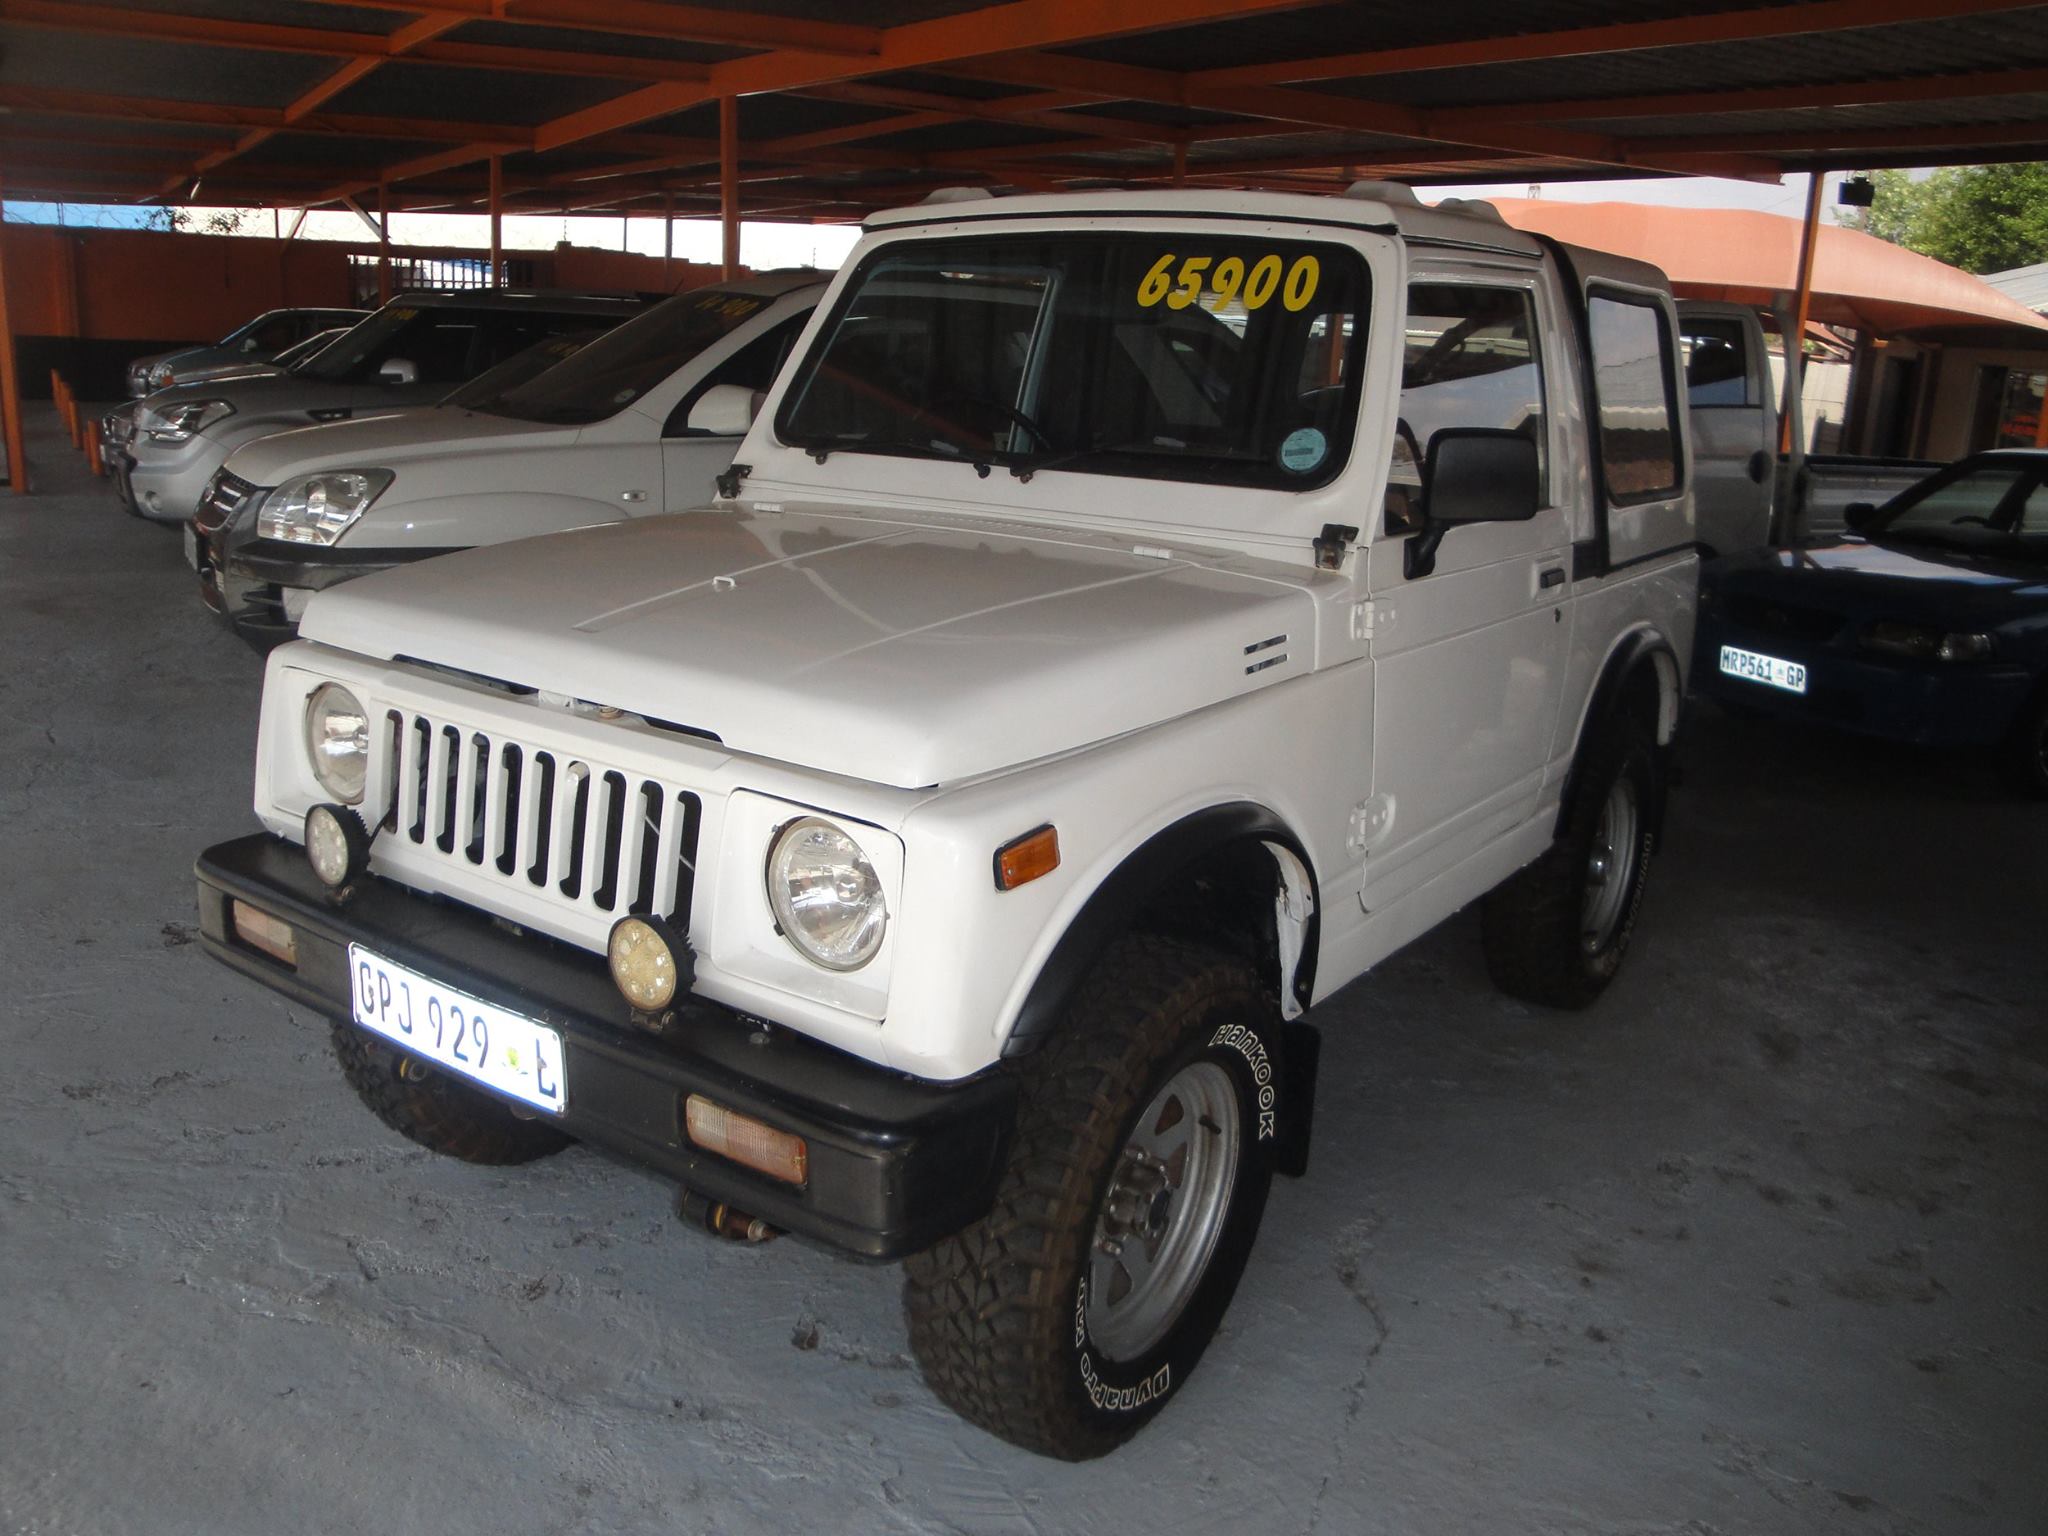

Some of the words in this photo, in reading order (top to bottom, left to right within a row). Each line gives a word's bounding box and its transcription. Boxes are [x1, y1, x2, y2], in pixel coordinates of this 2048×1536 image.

[1137, 254, 1320, 312] 65900
[1721, 649, 1773, 681] MRP561
[1787, 665, 1804, 687] GP
[359, 961, 413, 1035] GPJ
[428, 996, 488, 1068] 929
[536, 1038, 556, 1099] L
